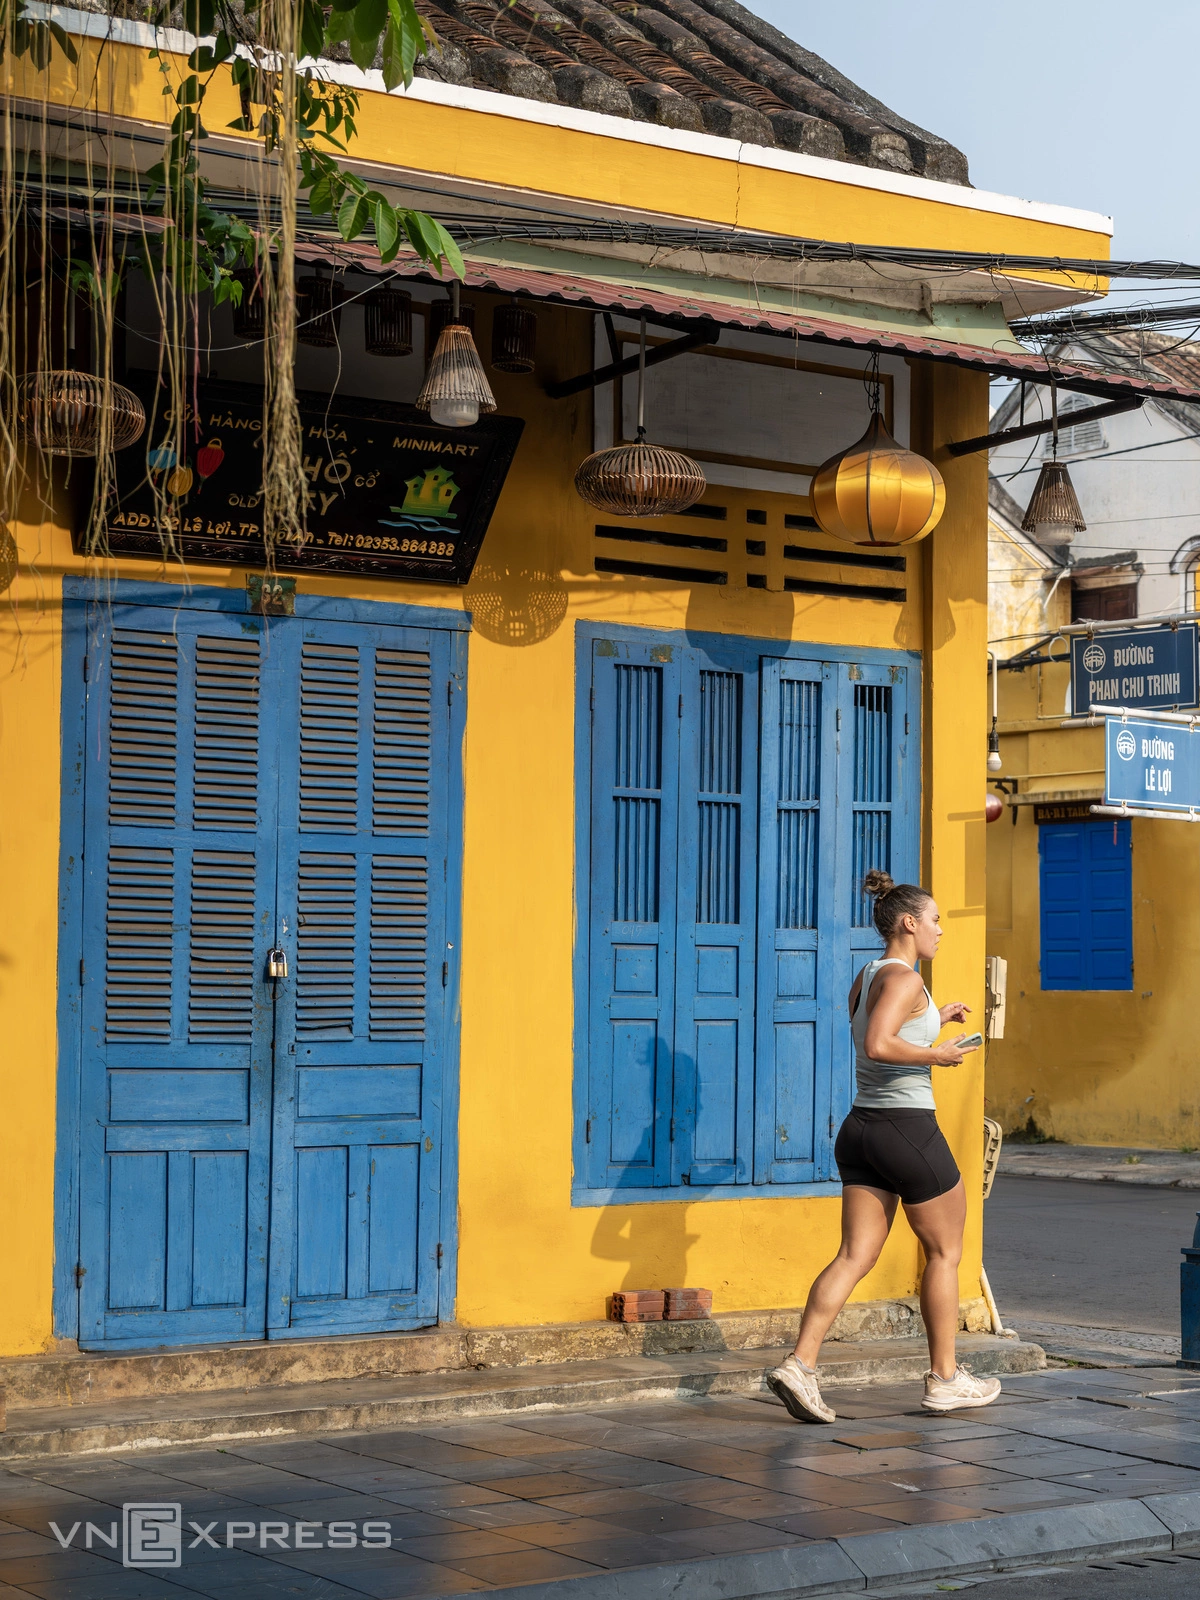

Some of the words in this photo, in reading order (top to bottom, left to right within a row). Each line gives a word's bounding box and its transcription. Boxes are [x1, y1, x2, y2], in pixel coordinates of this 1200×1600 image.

[209, 410, 262, 431] HÀNG
[308, 423, 348, 442] HÓA
[392, 436, 480, 457] MINIMART
[302, 448, 358, 484] HỐ
[228, 493, 260, 508] OLD
[1113, 643, 1154, 667] ĐƯỜNG
[1089, 677, 1119, 701] PHAN
[1122, 675, 1145, 699] CHU
[1146, 672, 1181, 696] TRINH
[1141, 735, 1175, 760] ĐƯỜNG
[1145, 765, 1156, 791] LÊ
[1157, 768, 1172, 796] LỢI
